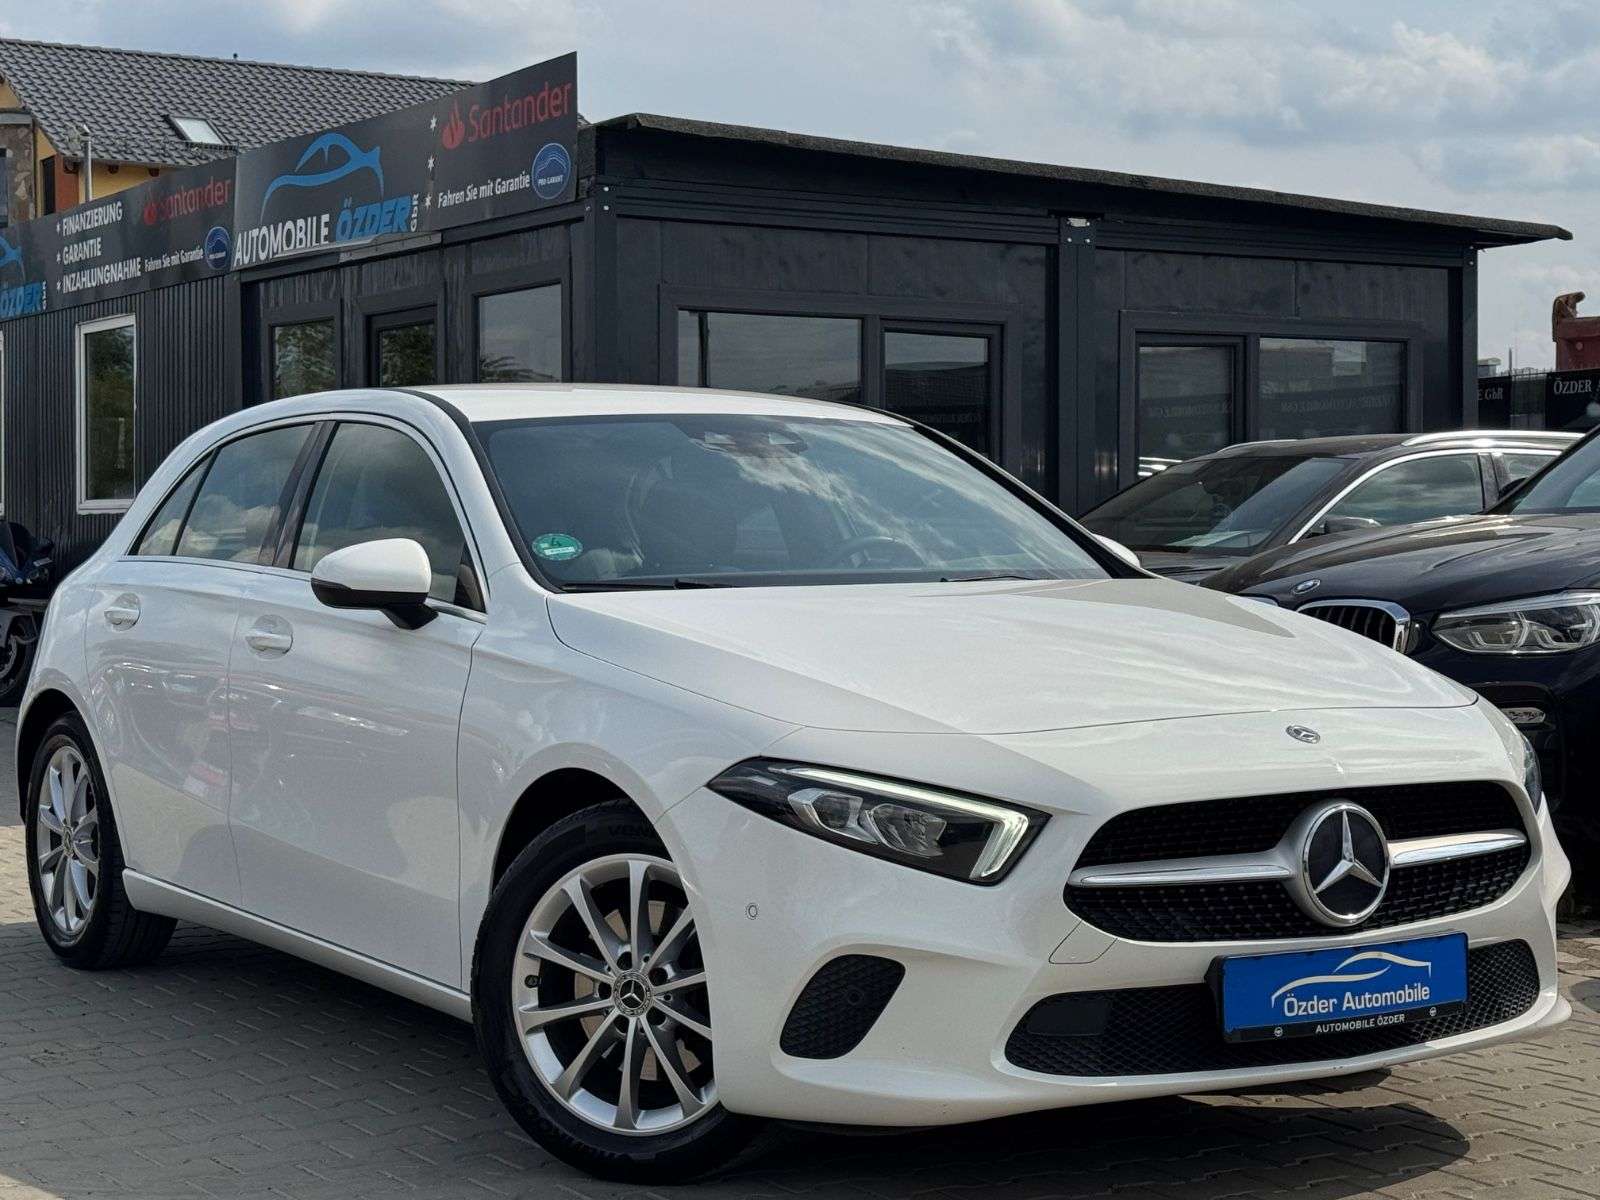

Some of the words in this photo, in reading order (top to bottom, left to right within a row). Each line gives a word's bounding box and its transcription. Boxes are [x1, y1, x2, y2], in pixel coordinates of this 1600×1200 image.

[467, 81, 573, 143] Santander
[438, 189, 464, 208] Fahren
[465, 184, 478, 202] Sie
[479, 179, 493, 199] mit
[495, 170, 530, 195] Garantie
[62, 201, 122, 236] FINANZIERUNG
[233, 213, 330, 267] AUTOMOBILE
[335, 196, 411, 243] ÖZDER
[62, 237, 102, 265] GARANTIE
[62, 257, 142, 293] INZAHLUNGNAHME
[1553, 377, 1592, 395] ÖZDER
[1284, 993, 1337, 1017] Özder
[1342, 983, 1430, 1011] Automobile
[1315, 1018, 1375, 1034] AUTOMOBILE
[1377, 1013, 1405, 1026] ÖZDER
